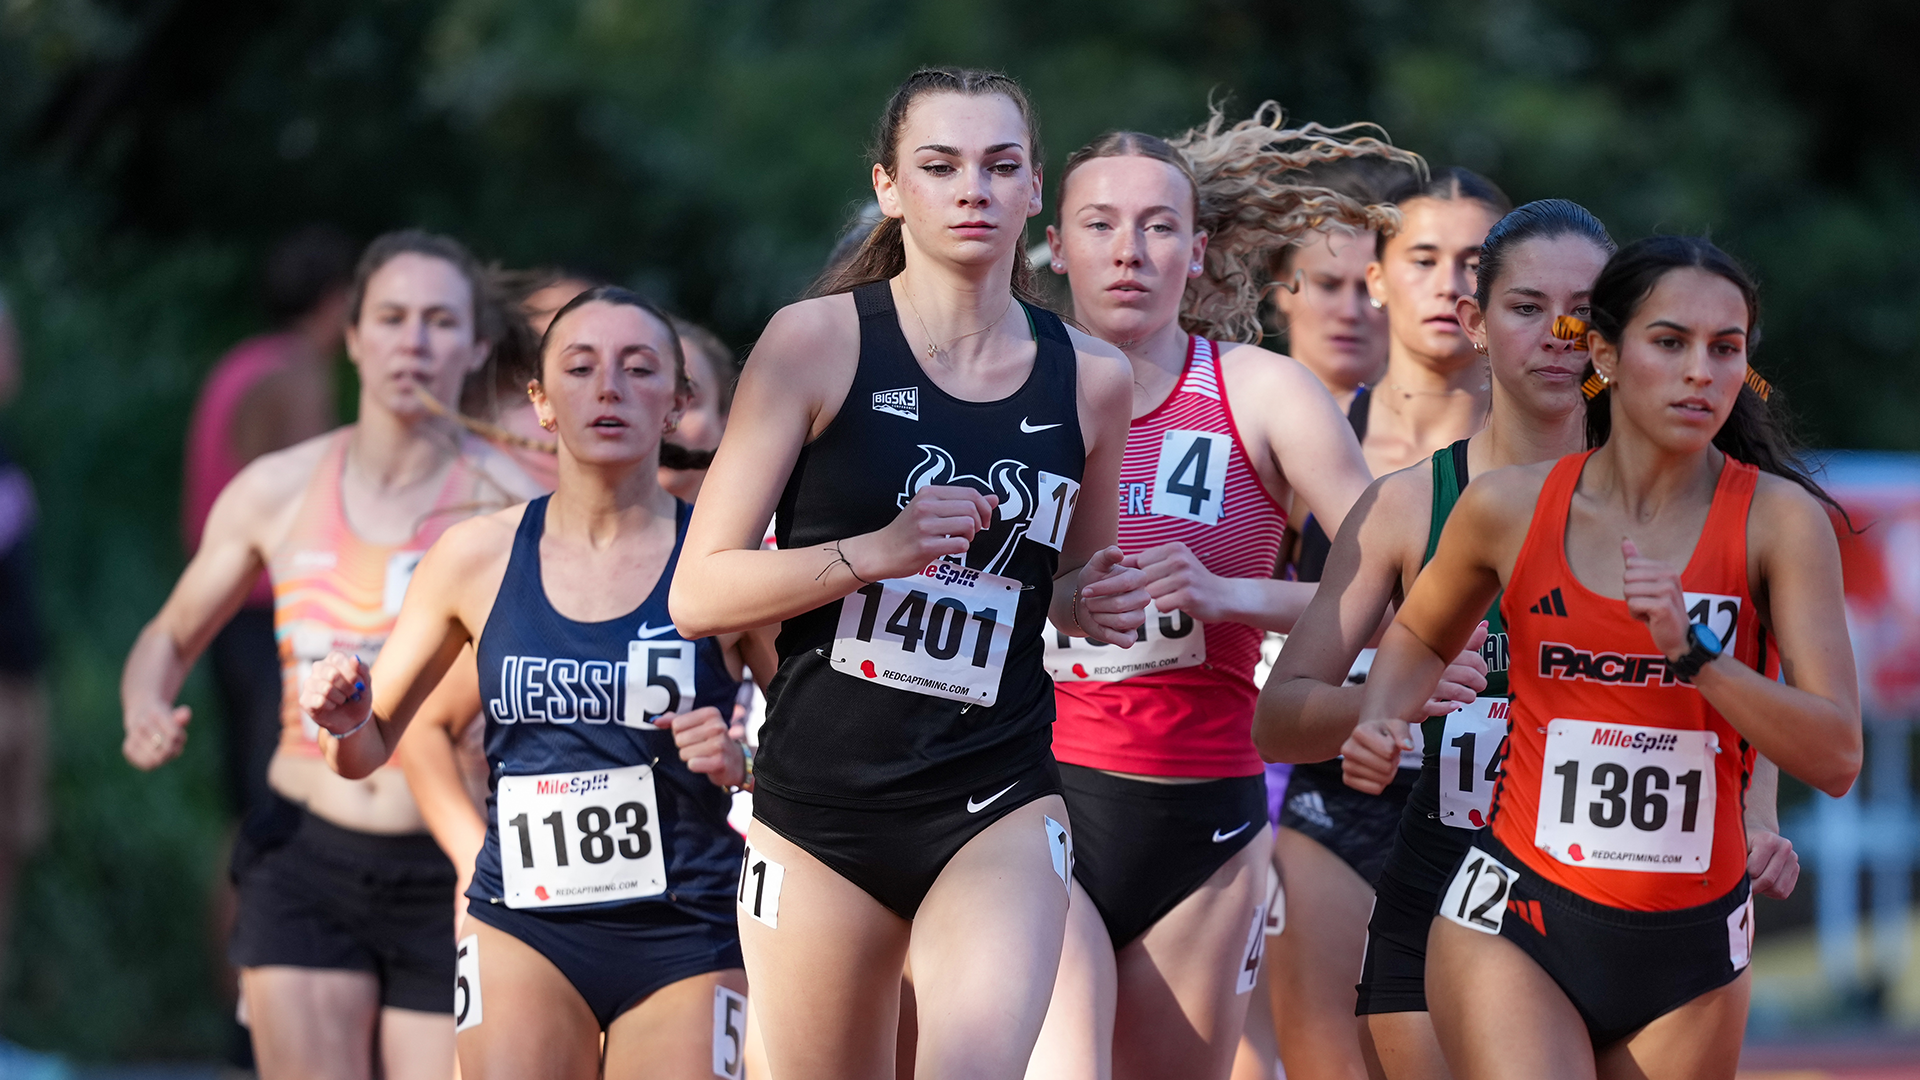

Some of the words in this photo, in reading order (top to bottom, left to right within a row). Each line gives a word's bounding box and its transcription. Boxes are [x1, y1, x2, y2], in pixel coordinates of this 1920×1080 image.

[1166, 437, 1212, 516] 4
[919, 563, 980, 588] eSplit
[855, 583, 998, 668] 1401
[643, 647, 681, 724] 5
[882, 669, 970, 697] REDCAPTIMING.COM
[1094, 657, 1179, 675] REDCAPTIMING.COM
[1538, 641, 1697, 688] PACIFI
[1591, 728, 1678, 753] MileSplit
[536, 773, 610, 796] MileSplit
[1554, 760, 1702, 833] 1361
[509, 801, 652, 869] 1183
[1591, 849, 1682, 865] REDCAPTIMING.COM
[555, 880, 639, 897] REDCAPTIMING.COM
[739, 846, 767, 918] 11
[1457, 857, 1508, 931] 12
[722, 998, 742, 1076] 5
